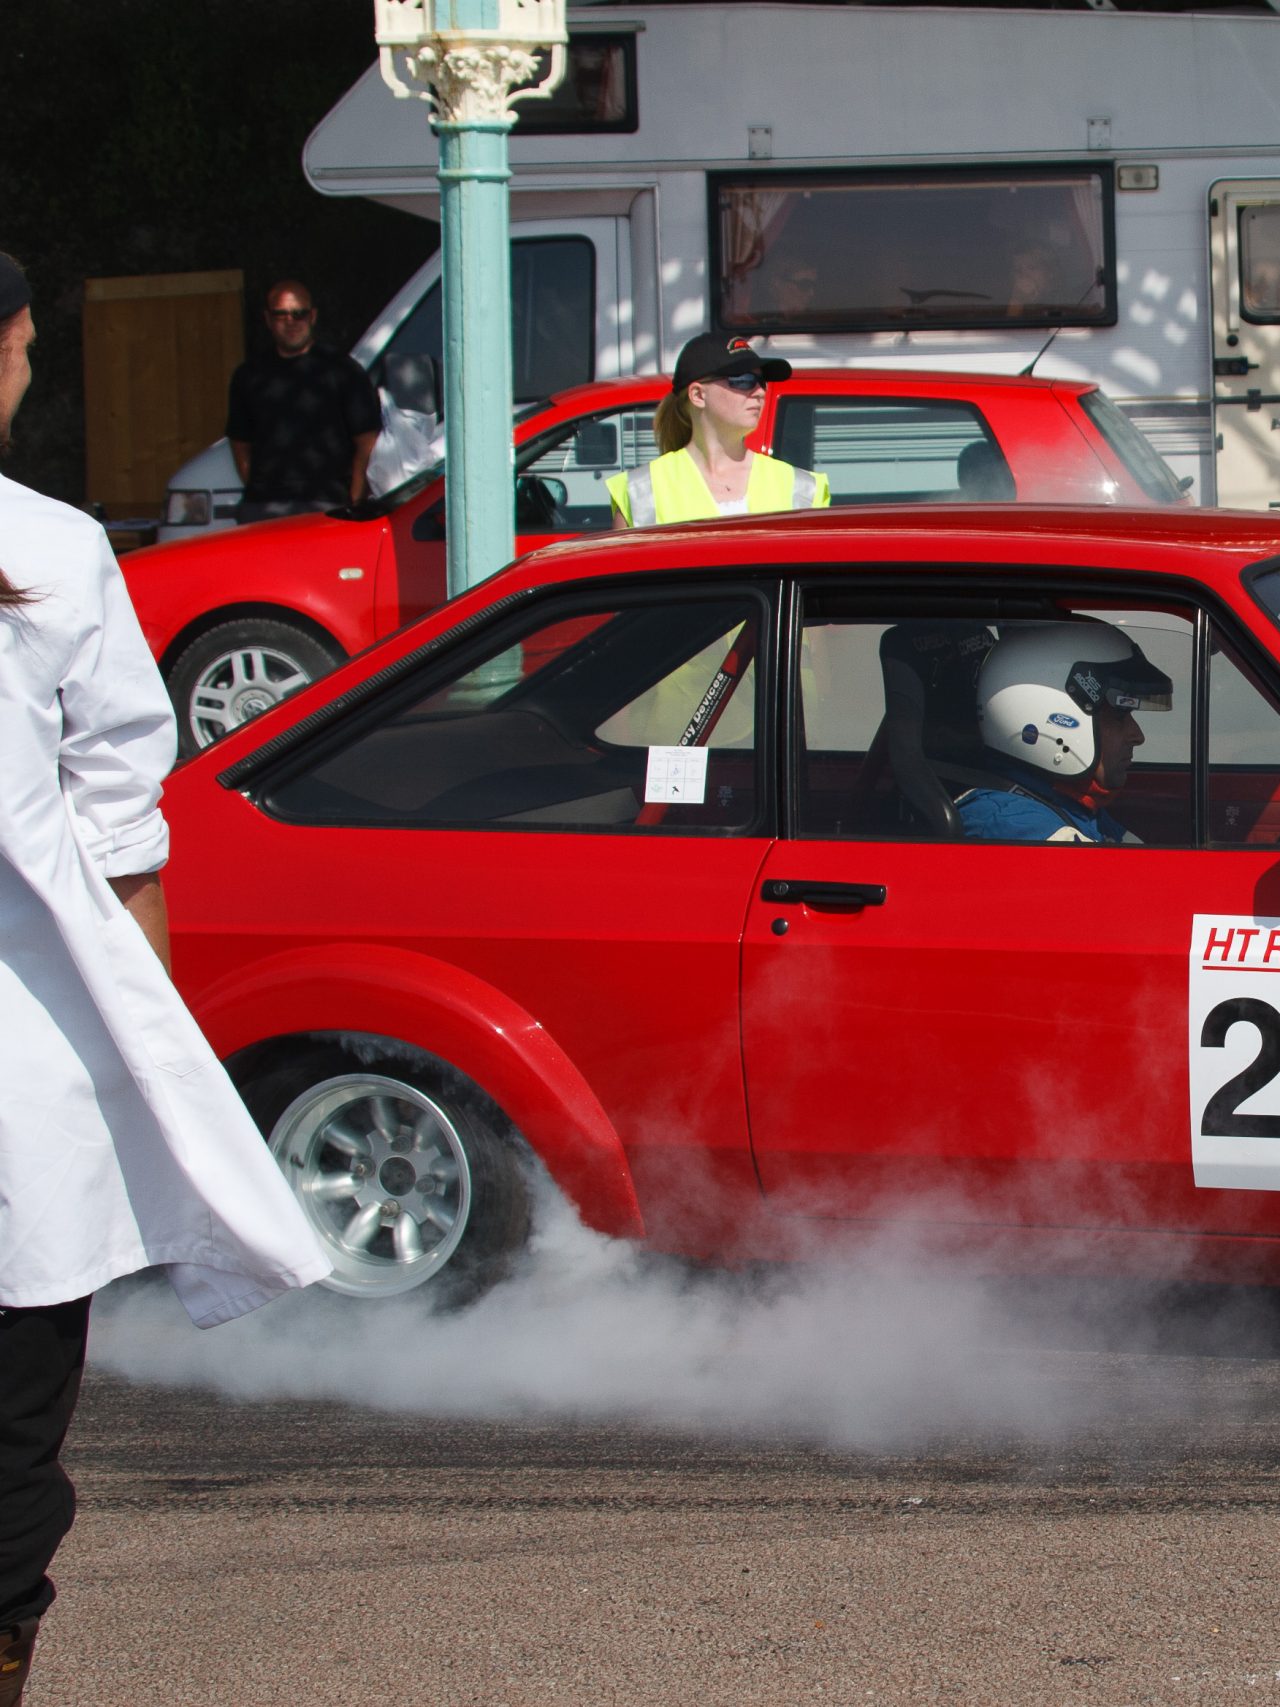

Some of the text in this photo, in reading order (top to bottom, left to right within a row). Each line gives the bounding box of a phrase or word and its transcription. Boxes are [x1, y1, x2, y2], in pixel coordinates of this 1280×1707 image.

[678, 723, 696, 747] ety
[693, 672, 724, 723] Devices
[1051, 713, 1076, 728] Ford
[1202, 927, 1260, 963] HT
